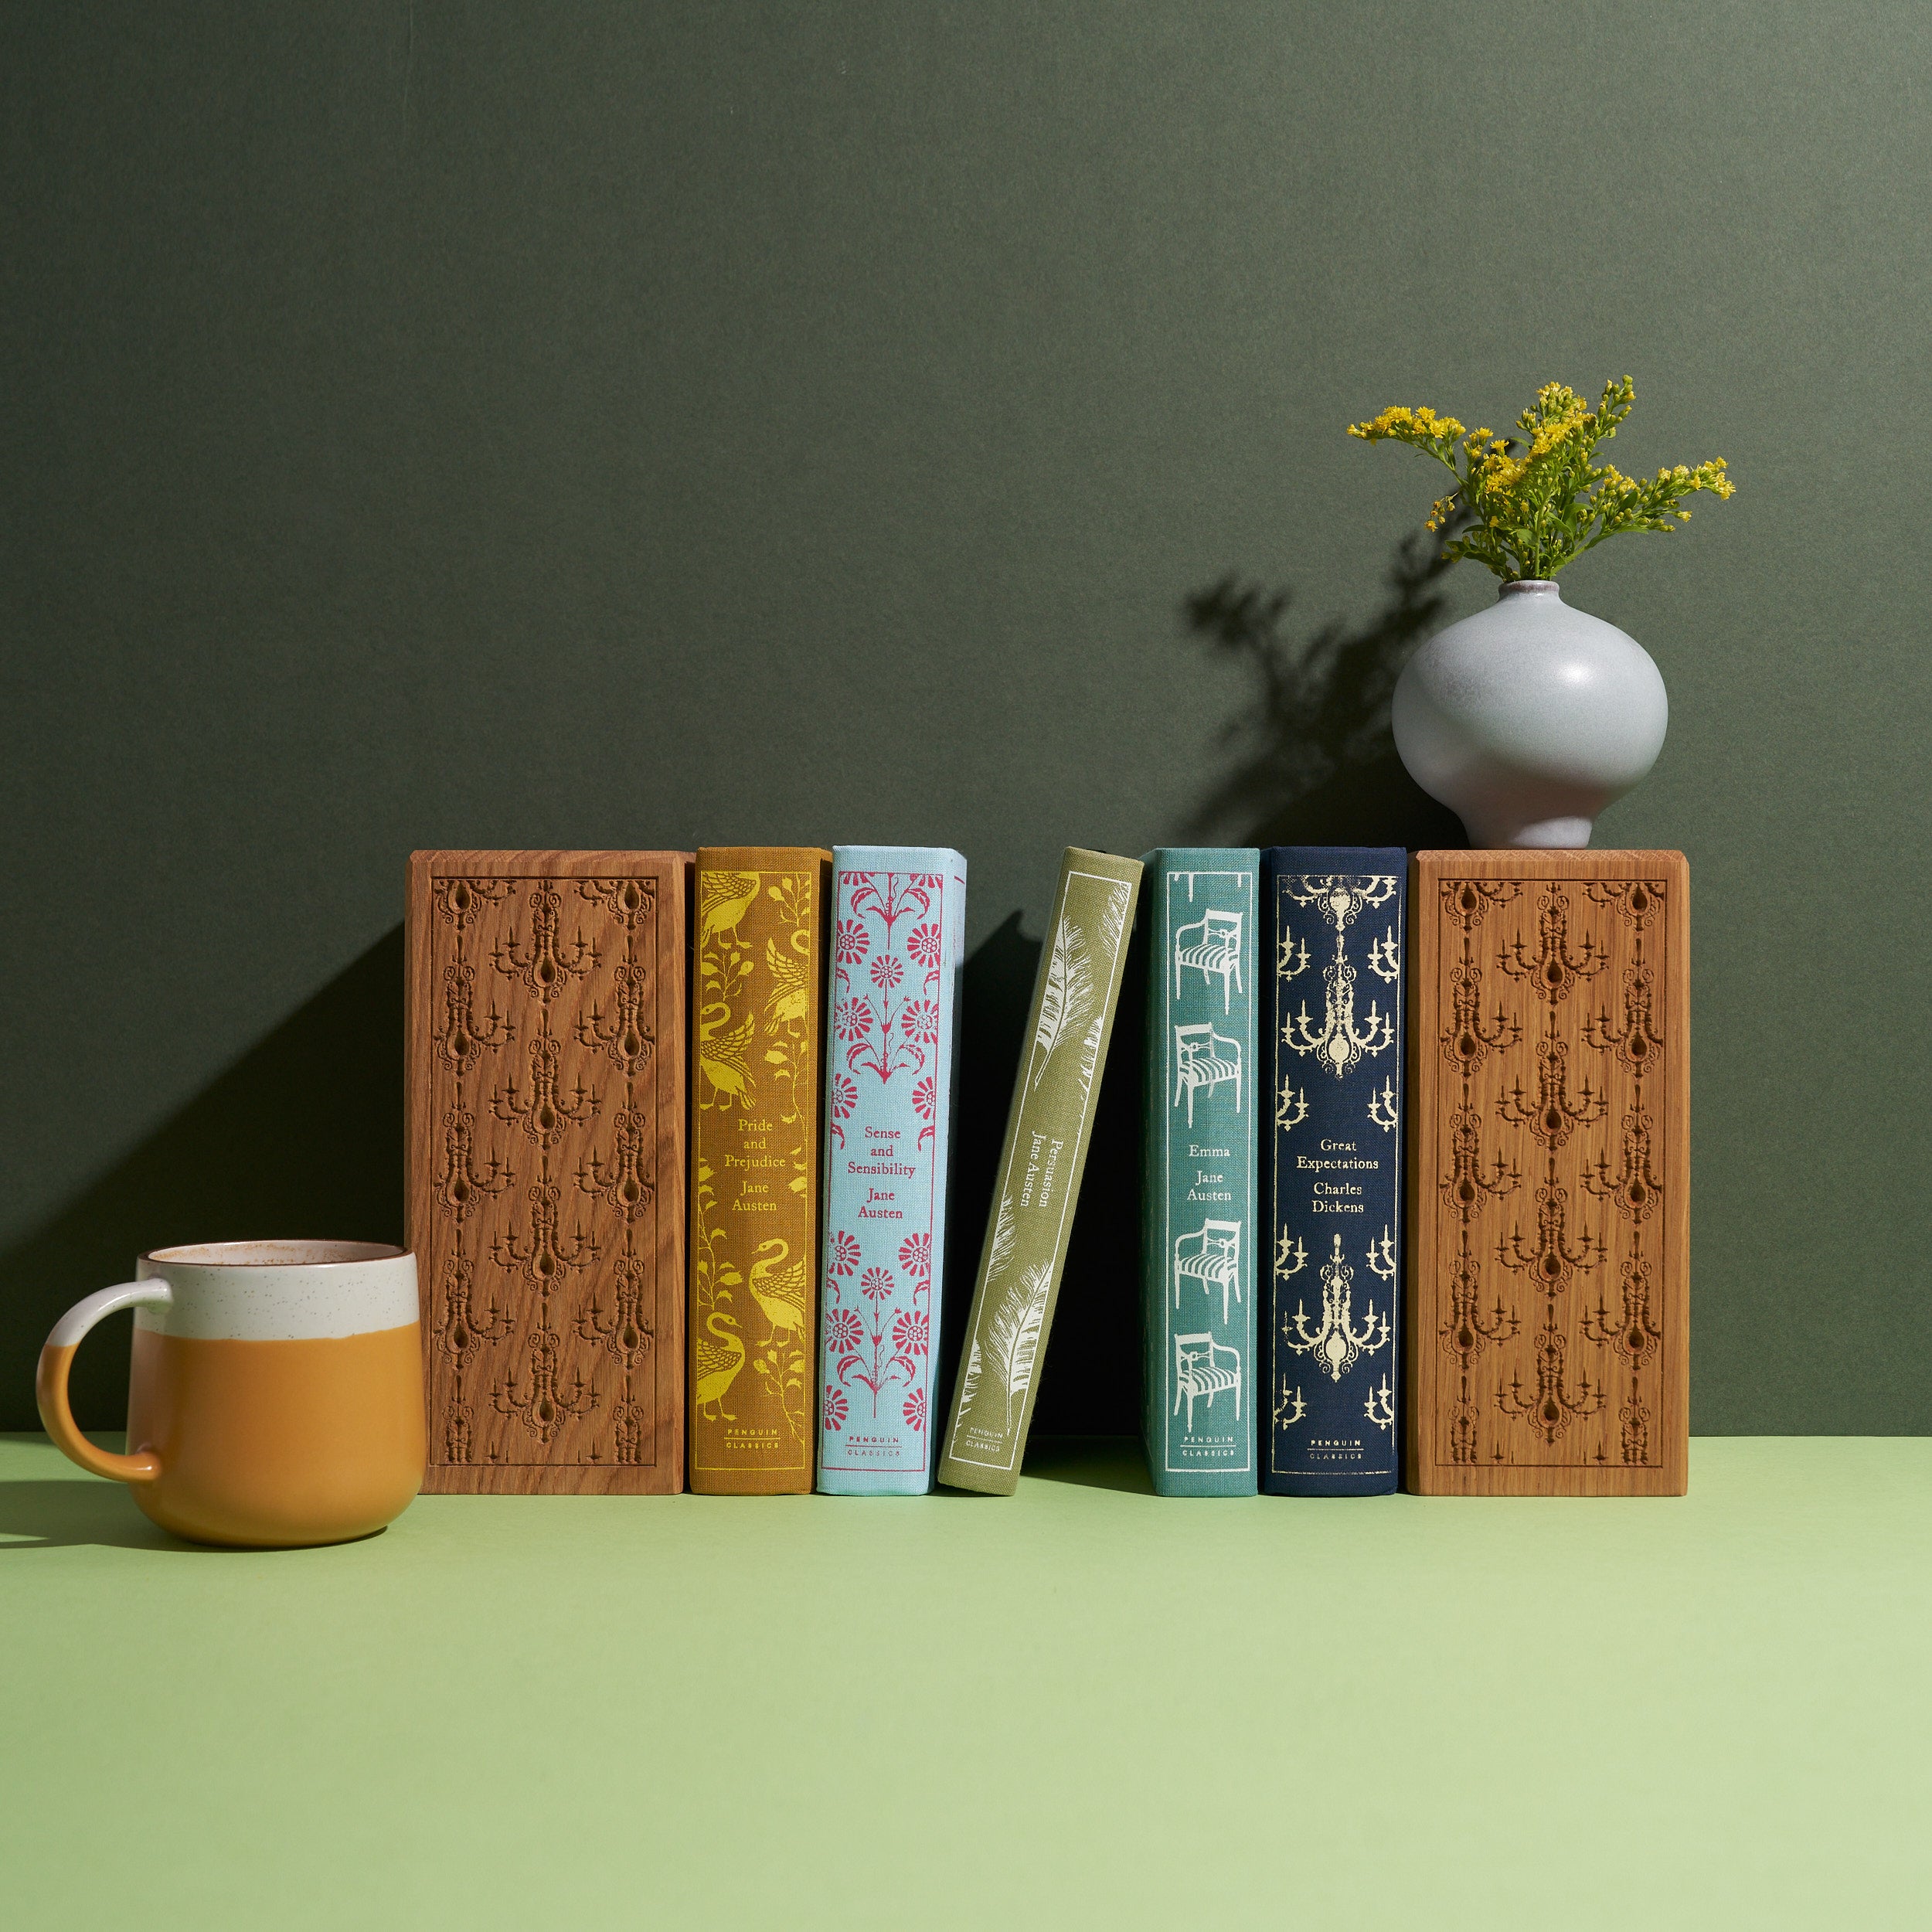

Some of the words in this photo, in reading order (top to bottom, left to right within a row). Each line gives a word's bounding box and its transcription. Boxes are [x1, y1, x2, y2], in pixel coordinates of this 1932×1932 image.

[738, 1118, 773, 1132] Pride
[864, 1126, 901, 1139] Sense
[743, 1138, 767, 1150] and
[1030, 1131, 1046, 1159] Jane
[1320, 1138, 1357, 1151] Great
[870, 1145, 894, 1158] and
[1189, 1145, 1231, 1158] Emma
[724, 1155, 786, 1172] Prejudice
[1296, 1156, 1379, 1172] Expectations
[847, 1162, 916, 1179] Sensibility
[1039, 1138, 1063, 1206] Persuasion
[1020, 1162, 1039, 1206] Austen
[1196, 1170, 1223, 1185] Jane
[742, 1181, 770, 1196] Jane
[1313, 1182, 1362, 1196] Charles
[866, 1188, 895, 1203] Jane
[1186, 1189, 1232, 1202] Austen
[731, 1199, 777, 1212] Austen
[1311, 1199, 1364, 1213] Dickens
[857, 1206, 903, 1219] Austen
[727, 1428, 779, 1437] PENGUIN
[970, 1427, 1003, 1438] PENGUIN
[725, 1441, 780, 1450] CLASSICS
[849, 1435, 900, 1444] PENGUIN
[965, 1440, 1000, 1451] CLASSICS
